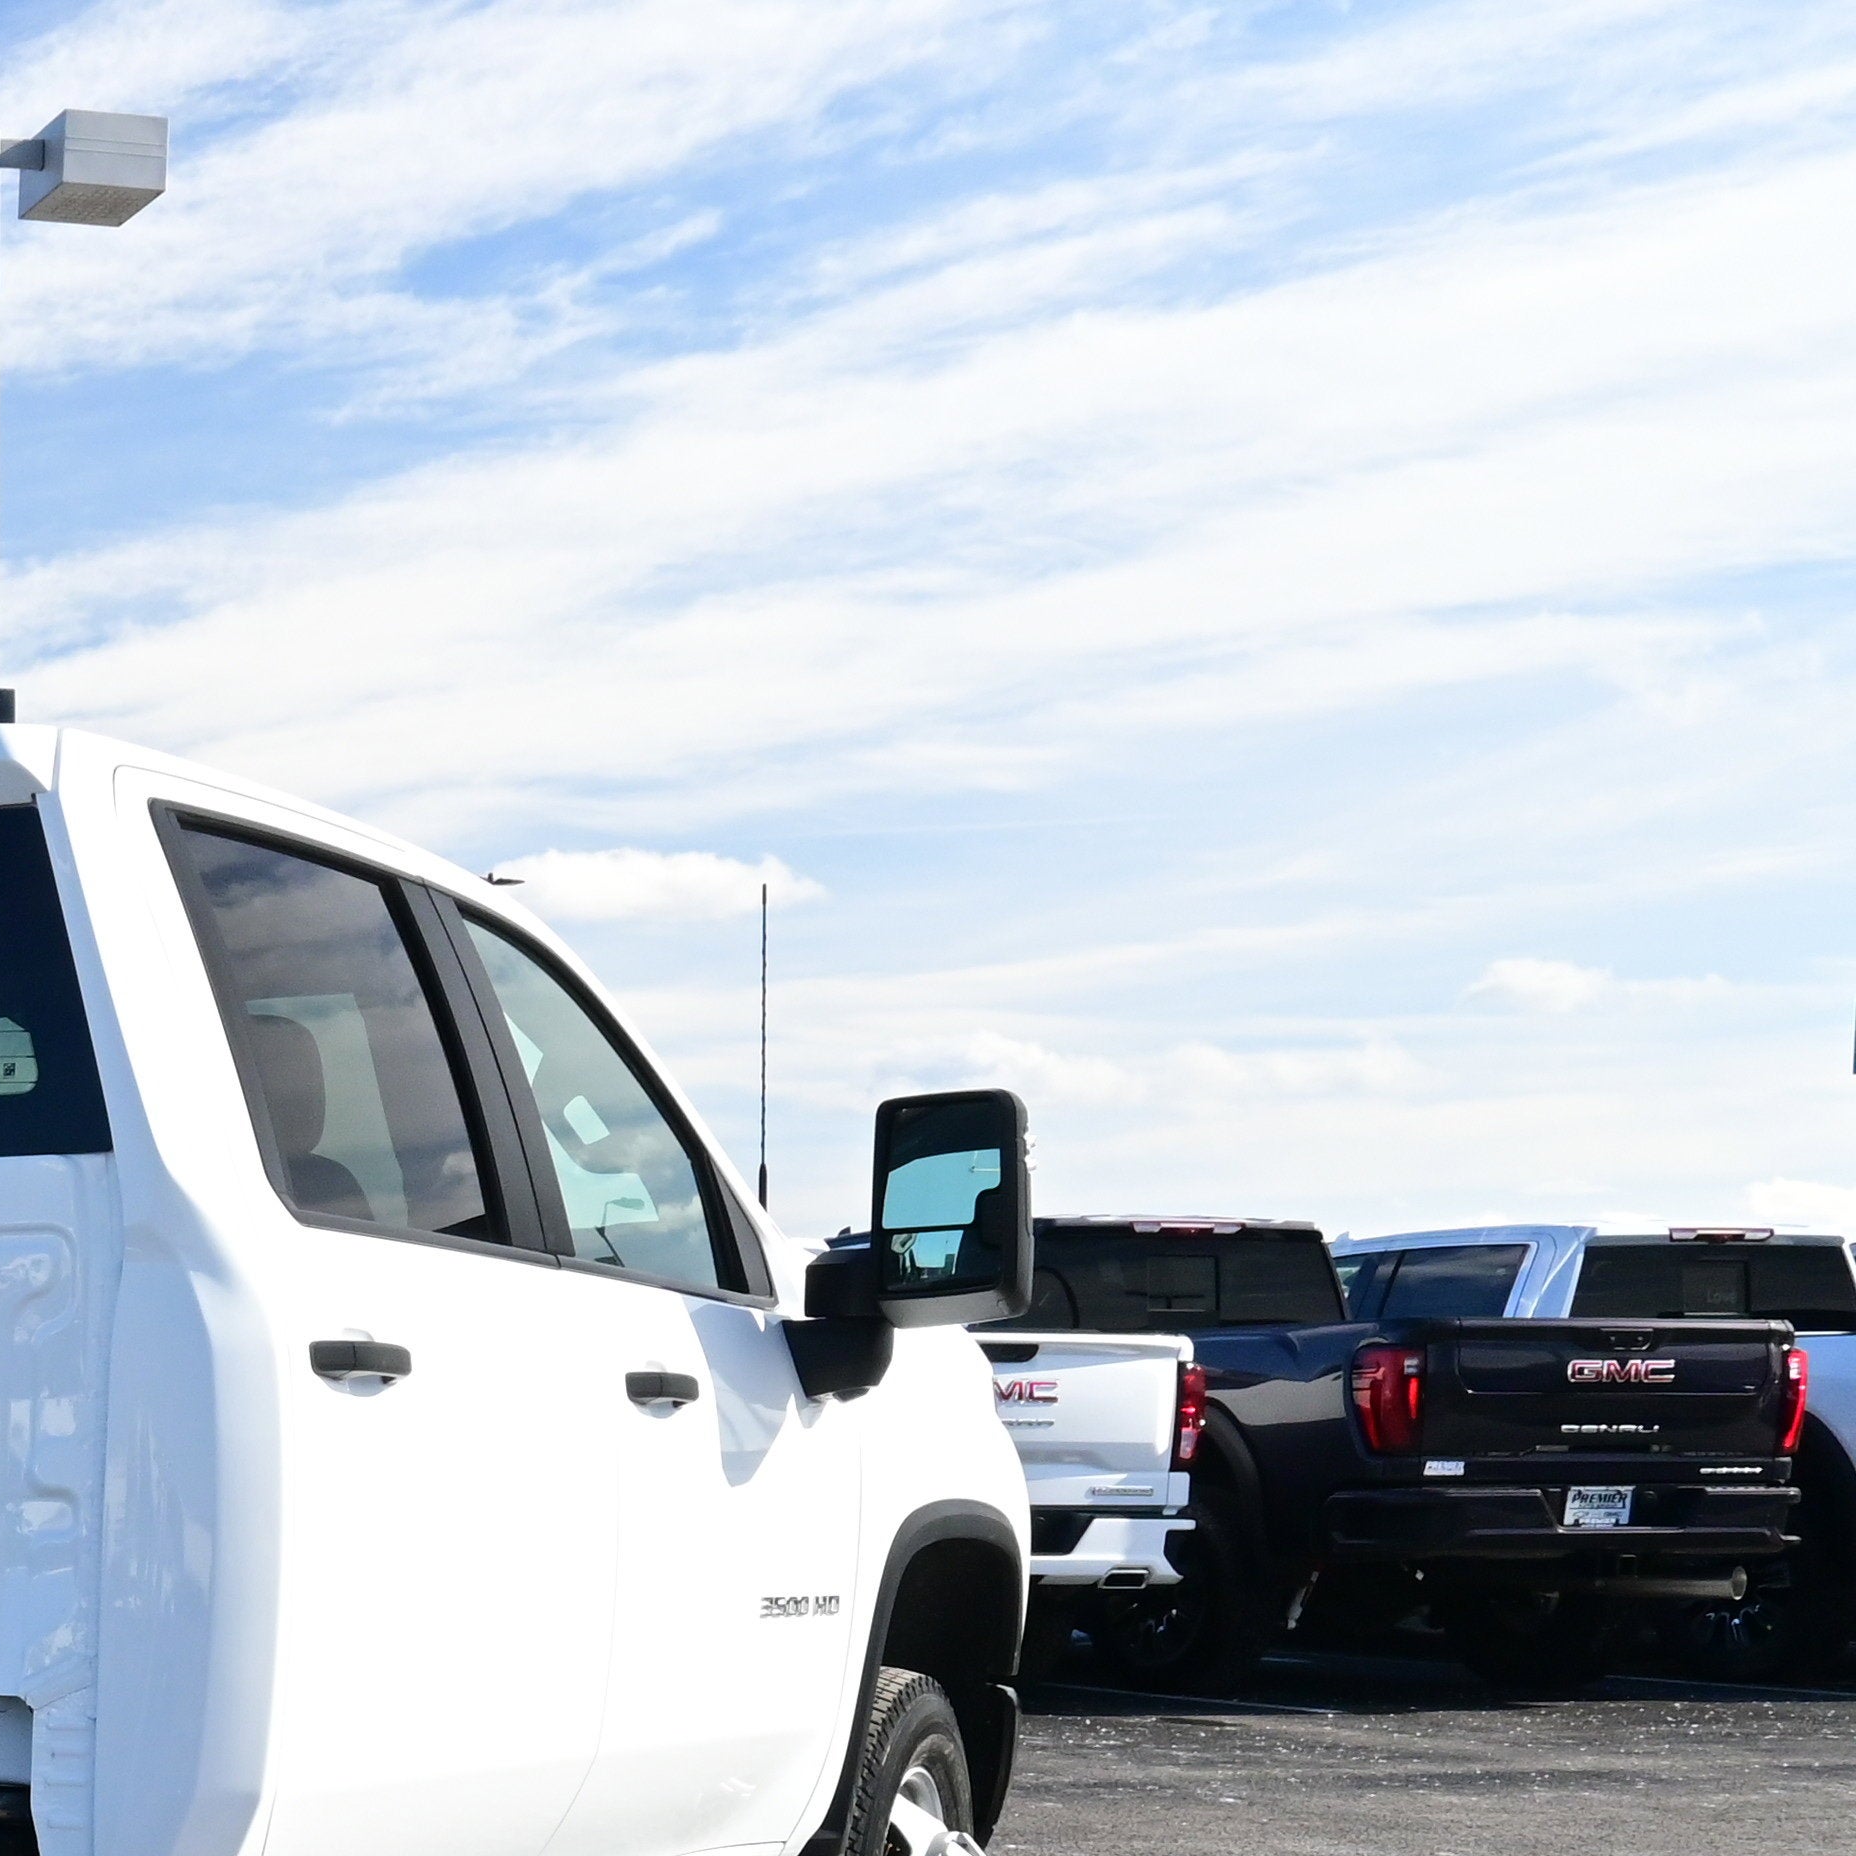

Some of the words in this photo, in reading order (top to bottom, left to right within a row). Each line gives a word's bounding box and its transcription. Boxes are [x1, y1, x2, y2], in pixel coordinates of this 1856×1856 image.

[1567, 1359, 1675, 1383] GMC
[994, 1379, 1059, 1403] MC
[1571, 1492, 1628, 1507] PREMIER
[759, 1596, 809, 1619] 3500
[812, 1595, 840, 1617] HD
